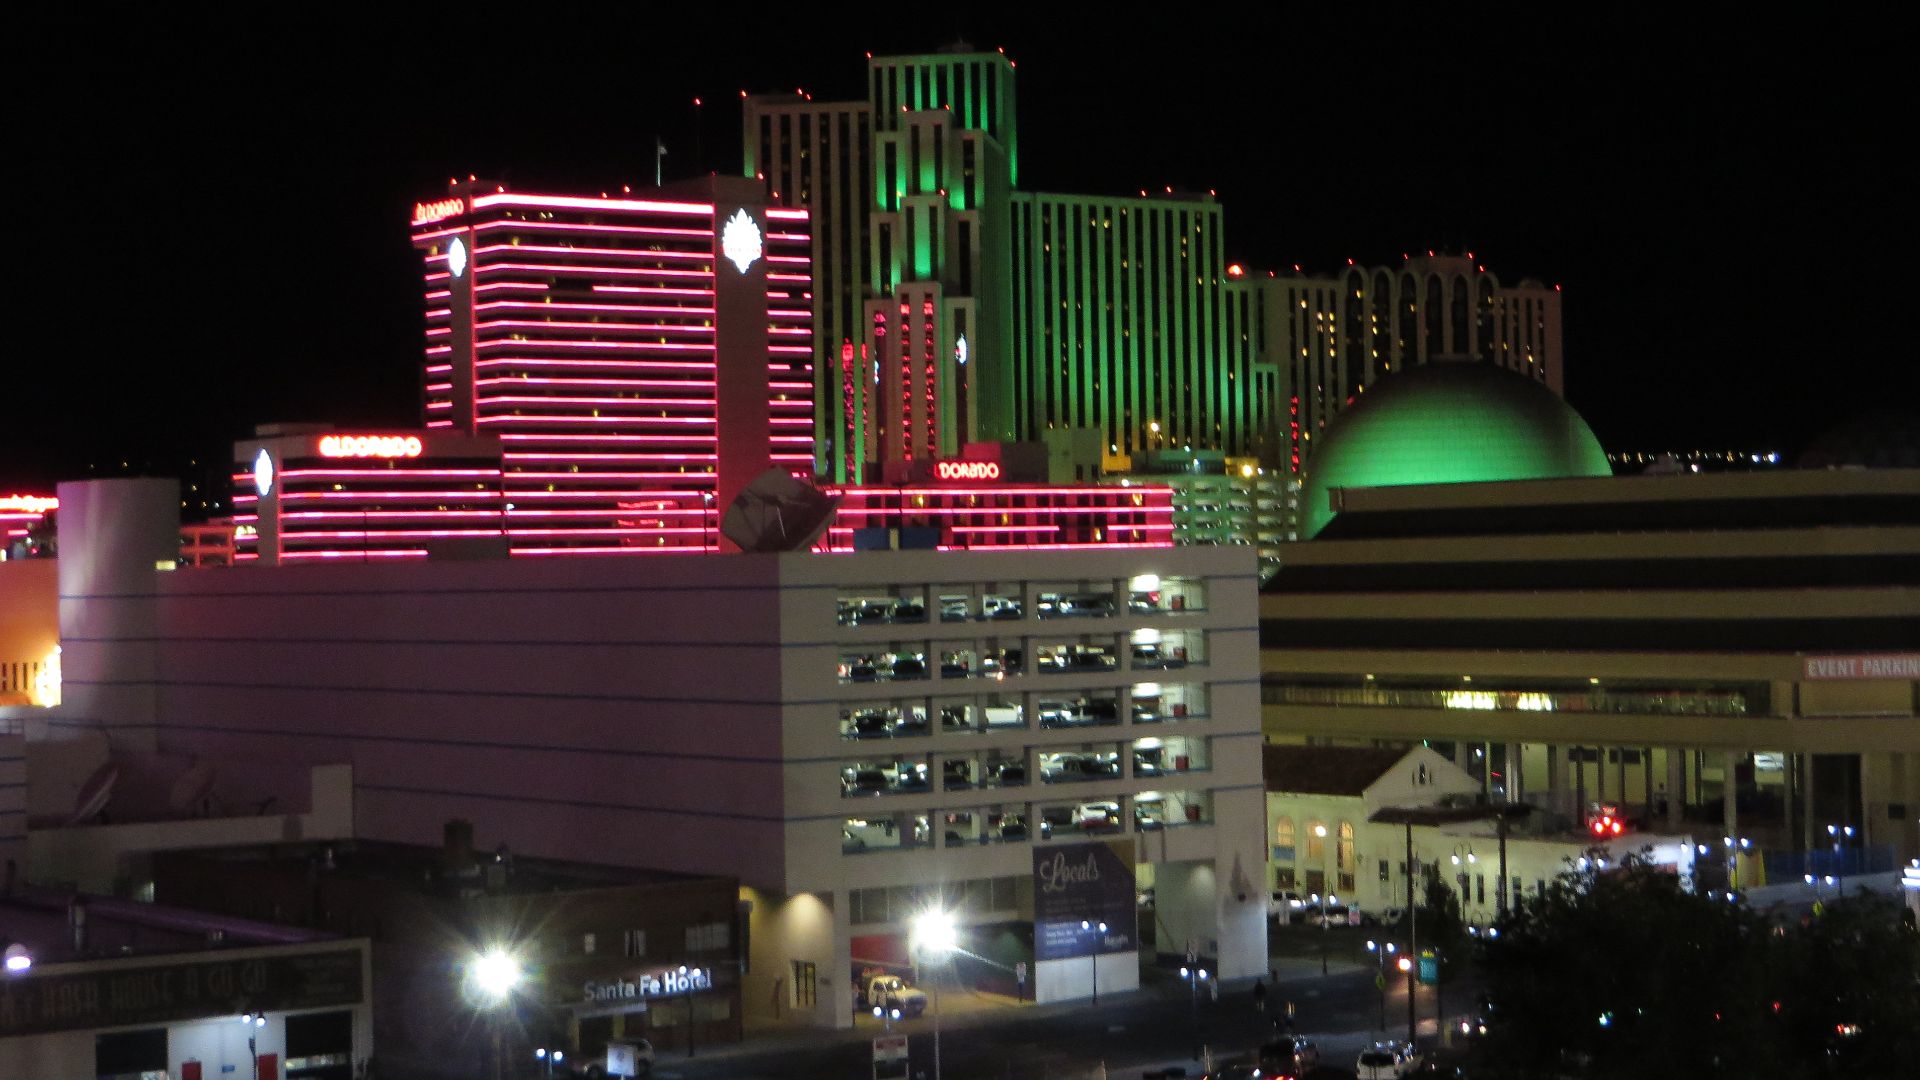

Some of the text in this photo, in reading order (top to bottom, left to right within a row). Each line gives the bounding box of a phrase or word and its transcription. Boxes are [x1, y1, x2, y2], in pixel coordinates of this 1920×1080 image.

[1807, 659, 1857, 677] EVENT
[1039, 851, 1099, 892] Locals
[111, 971, 173, 1010] HOUSE
[185, 968, 199, 1002] A
[207, 965, 234, 999] GO
[241, 959, 268, 994] GO
[583, 967, 712, 1001] Santa Fe Hotel
